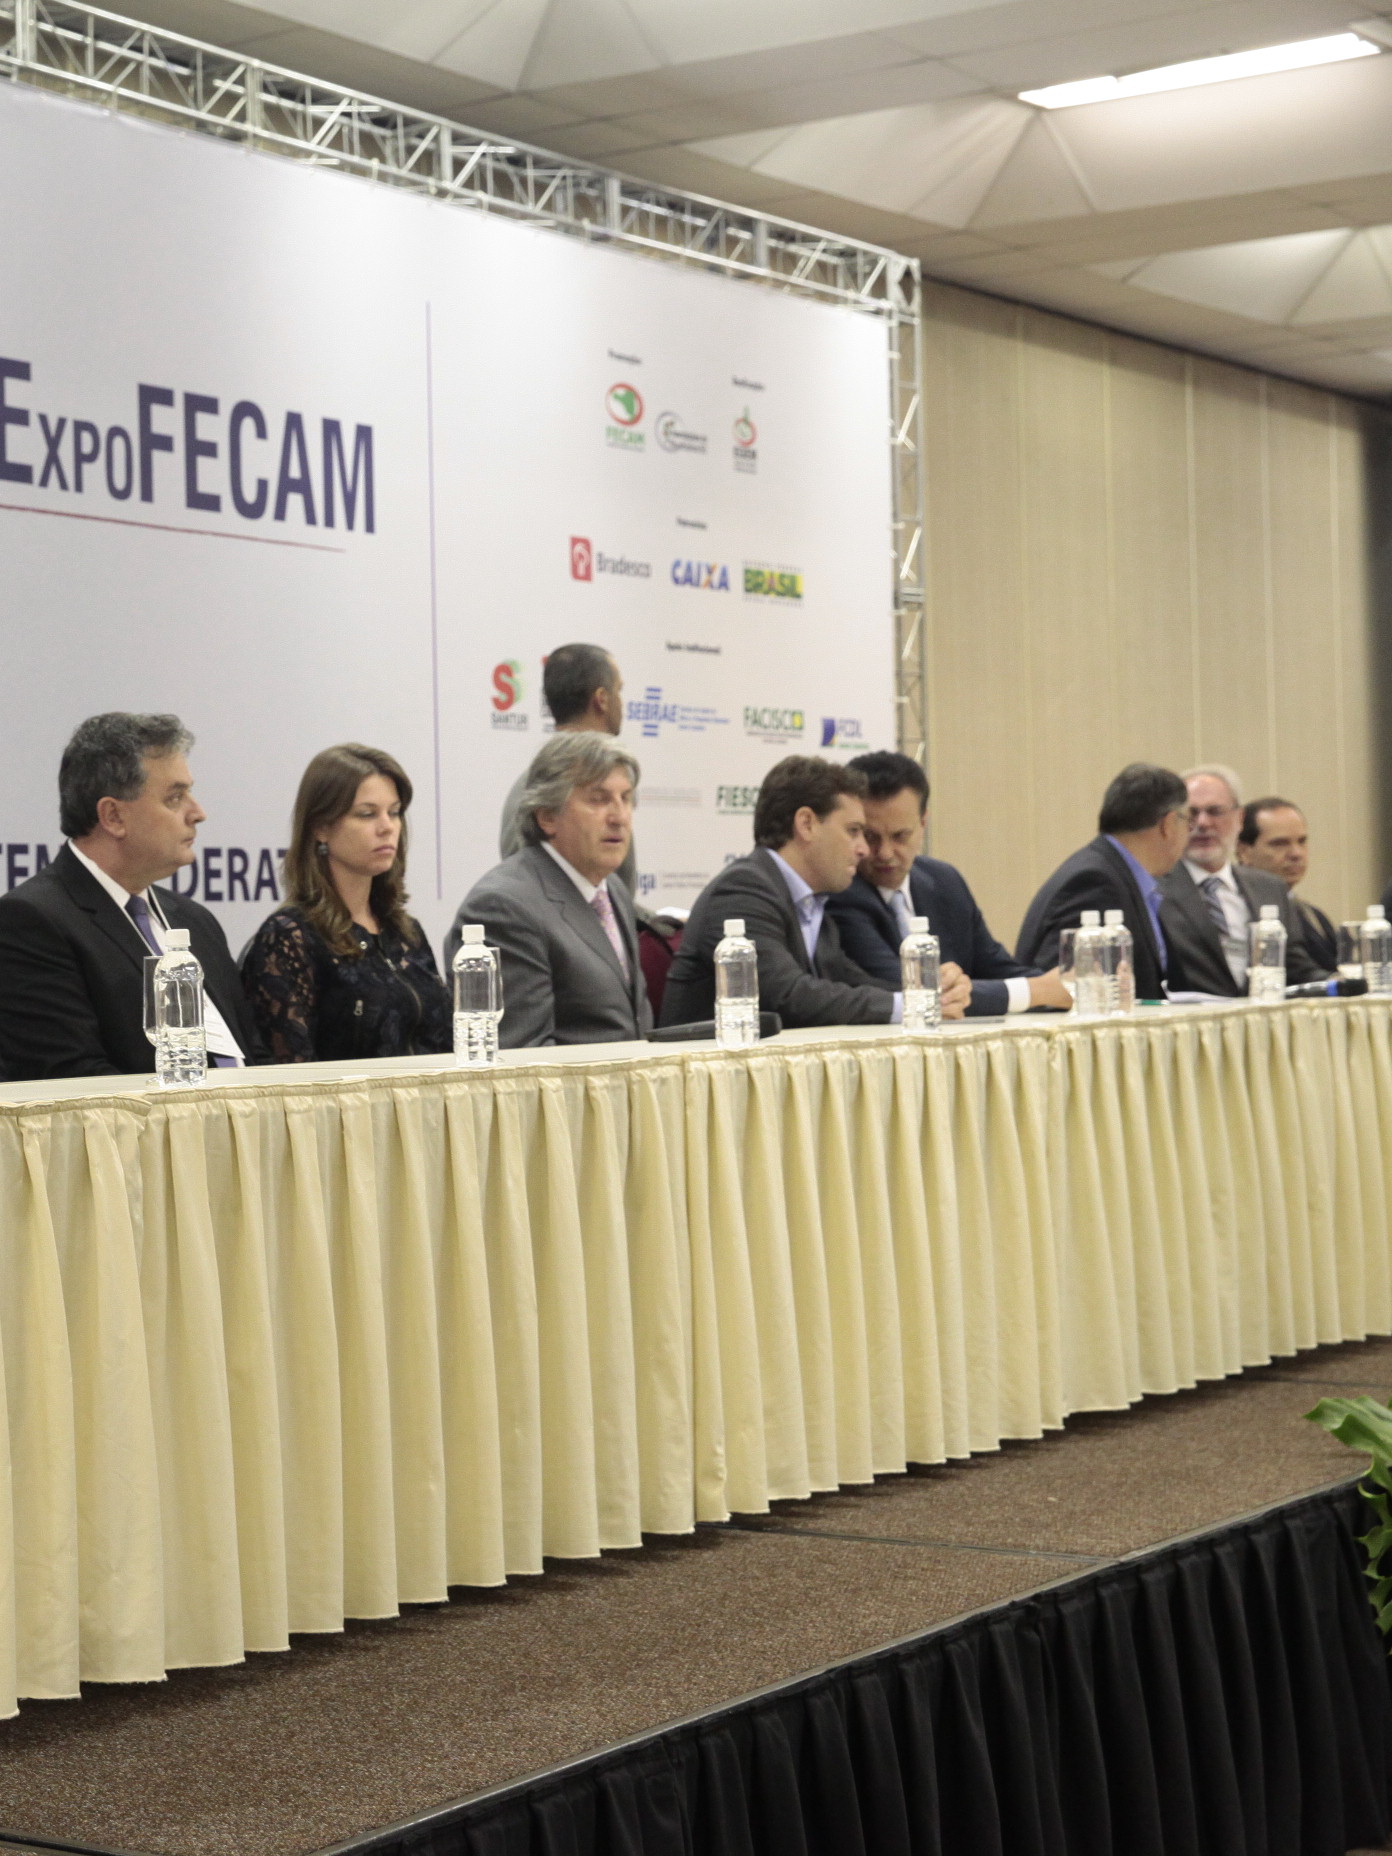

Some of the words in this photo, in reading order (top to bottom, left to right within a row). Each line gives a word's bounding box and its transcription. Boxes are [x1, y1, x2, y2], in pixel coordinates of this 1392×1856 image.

[597, 552, 652, 579] Bradesco
[671, 559, 731, 592] CAIXA
[744, 568, 803, 599] BRASIL
[626, 700, 678, 724] SEBRAE
